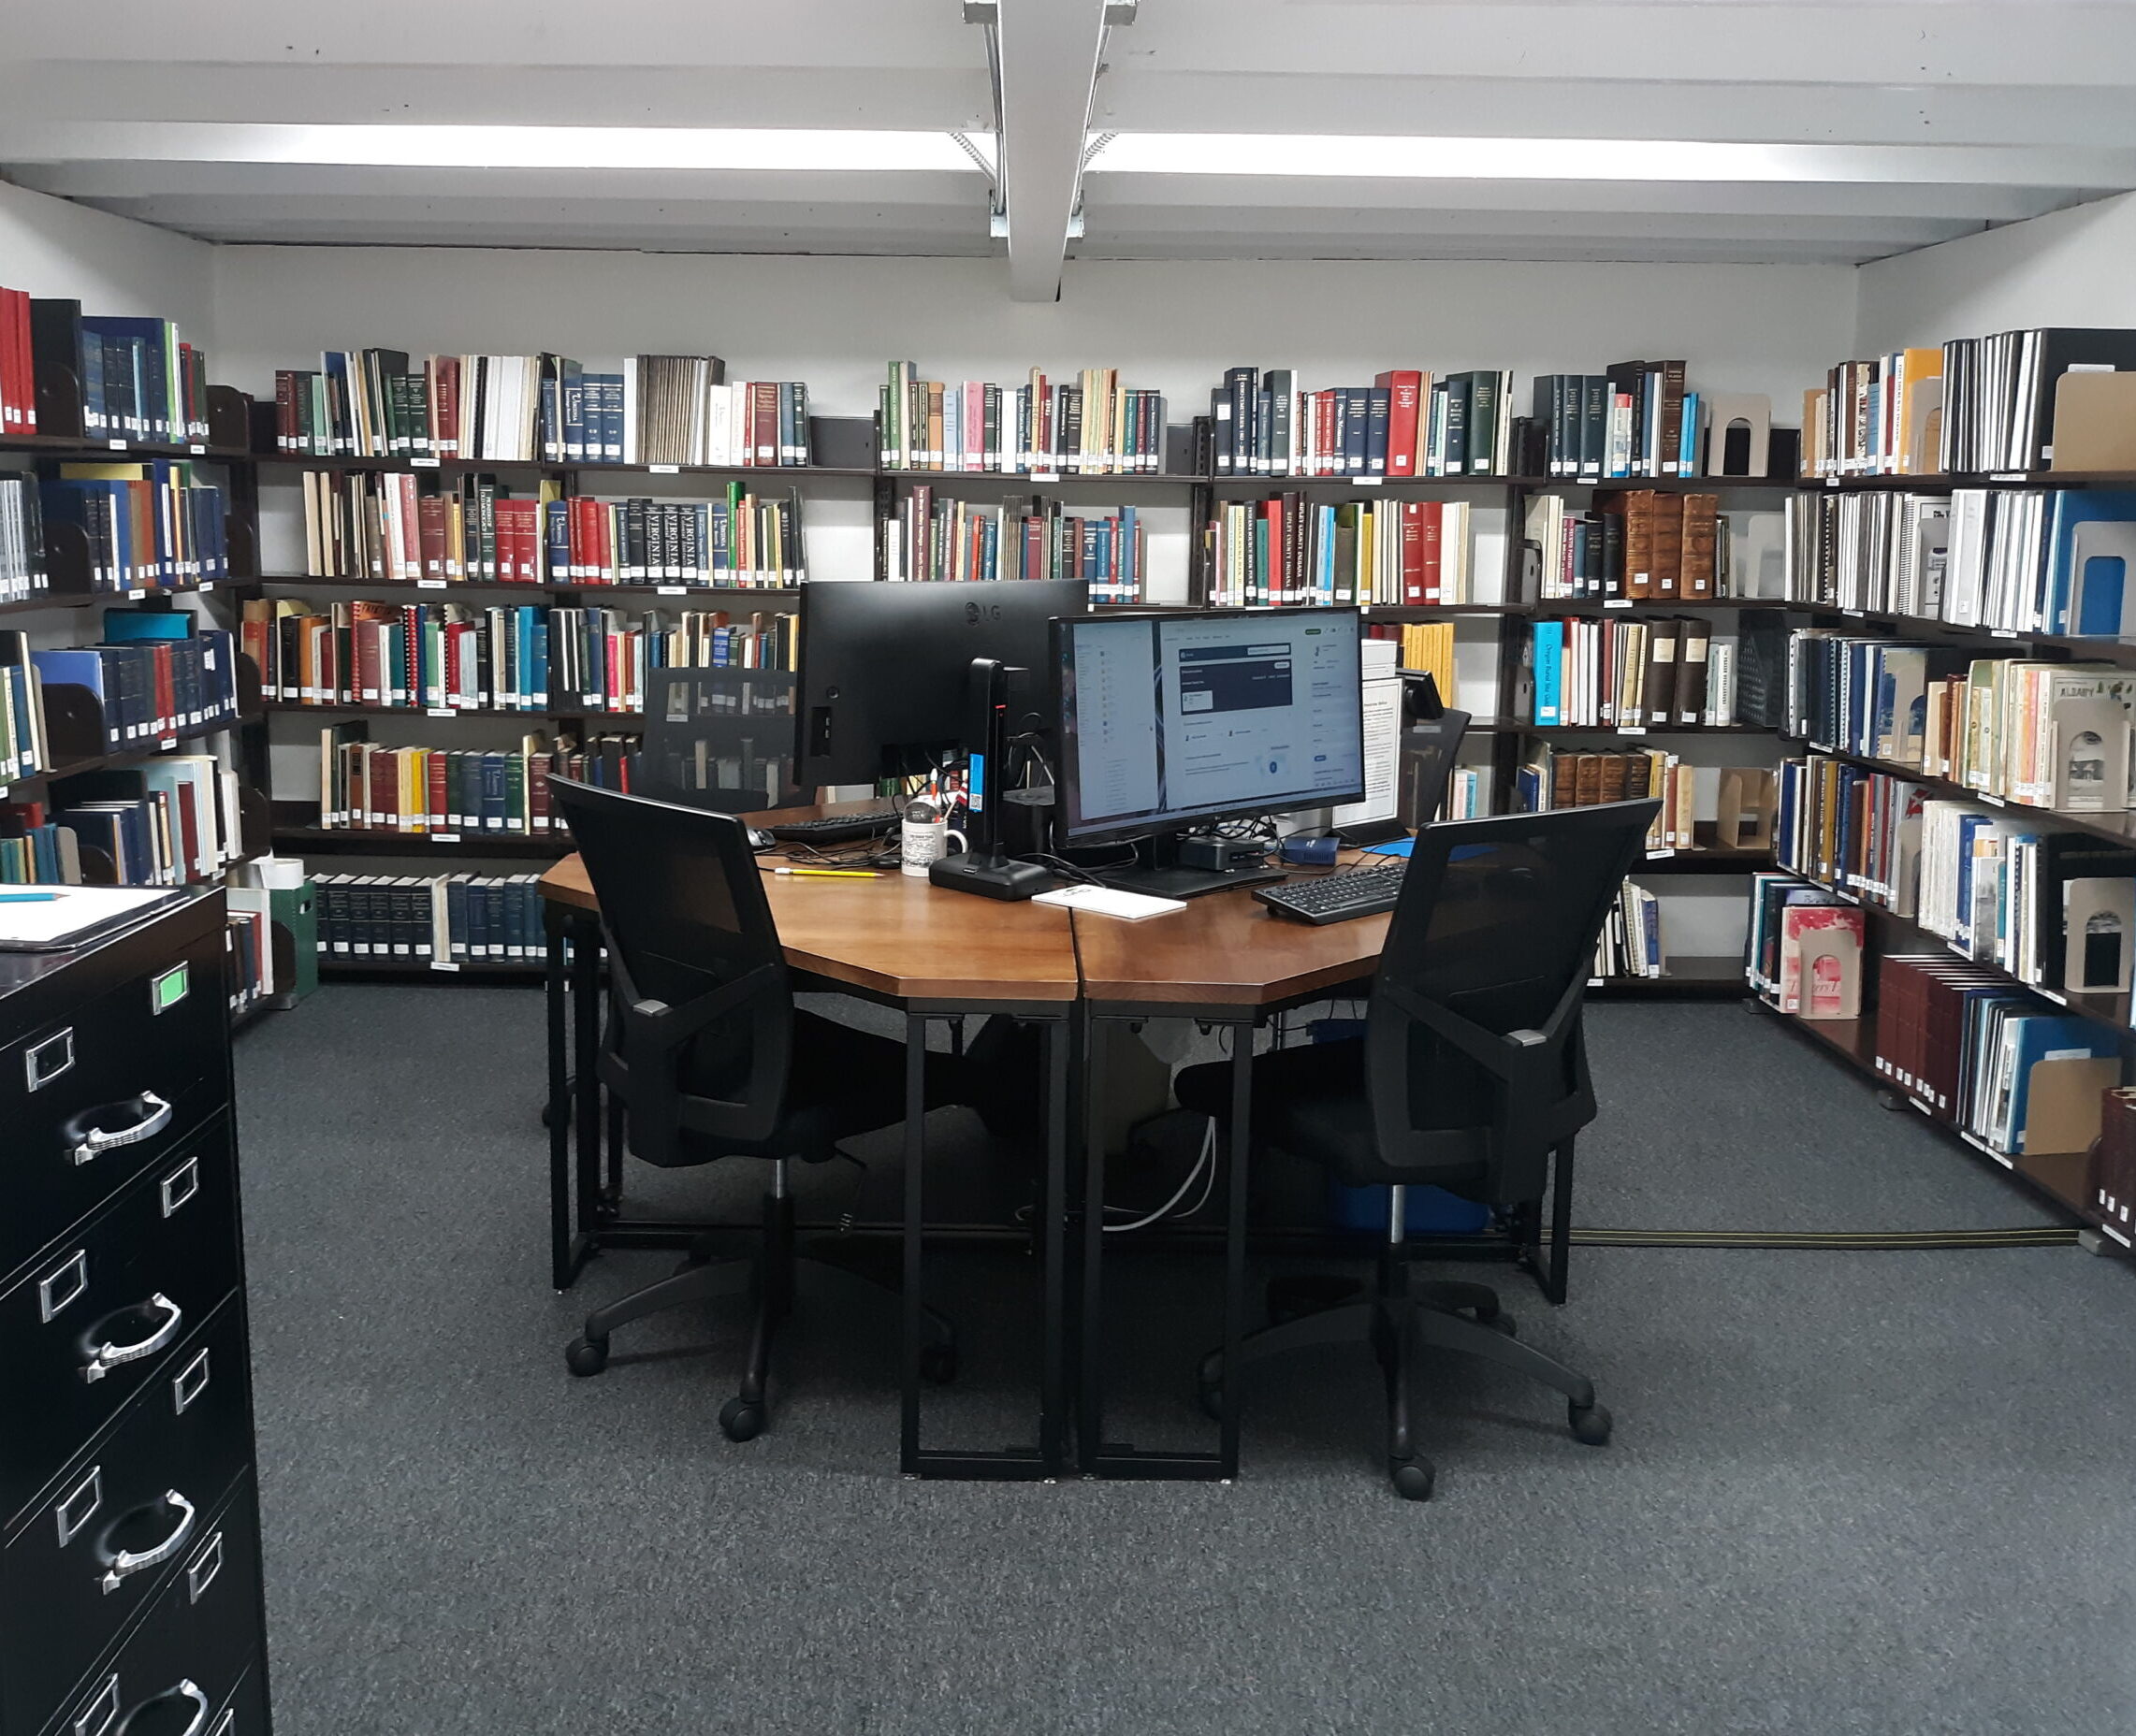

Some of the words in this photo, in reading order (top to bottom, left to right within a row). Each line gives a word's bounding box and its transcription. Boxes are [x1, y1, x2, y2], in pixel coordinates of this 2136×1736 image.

[651, 514, 660, 565] VIRGINIA
[670, 514, 678, 564] VIRGINIA
[686, 515, 695, 566] VIRGINIA
[982, 604, 1002, 622] LG
[2059, 687, 2094, 698] ALBANY
